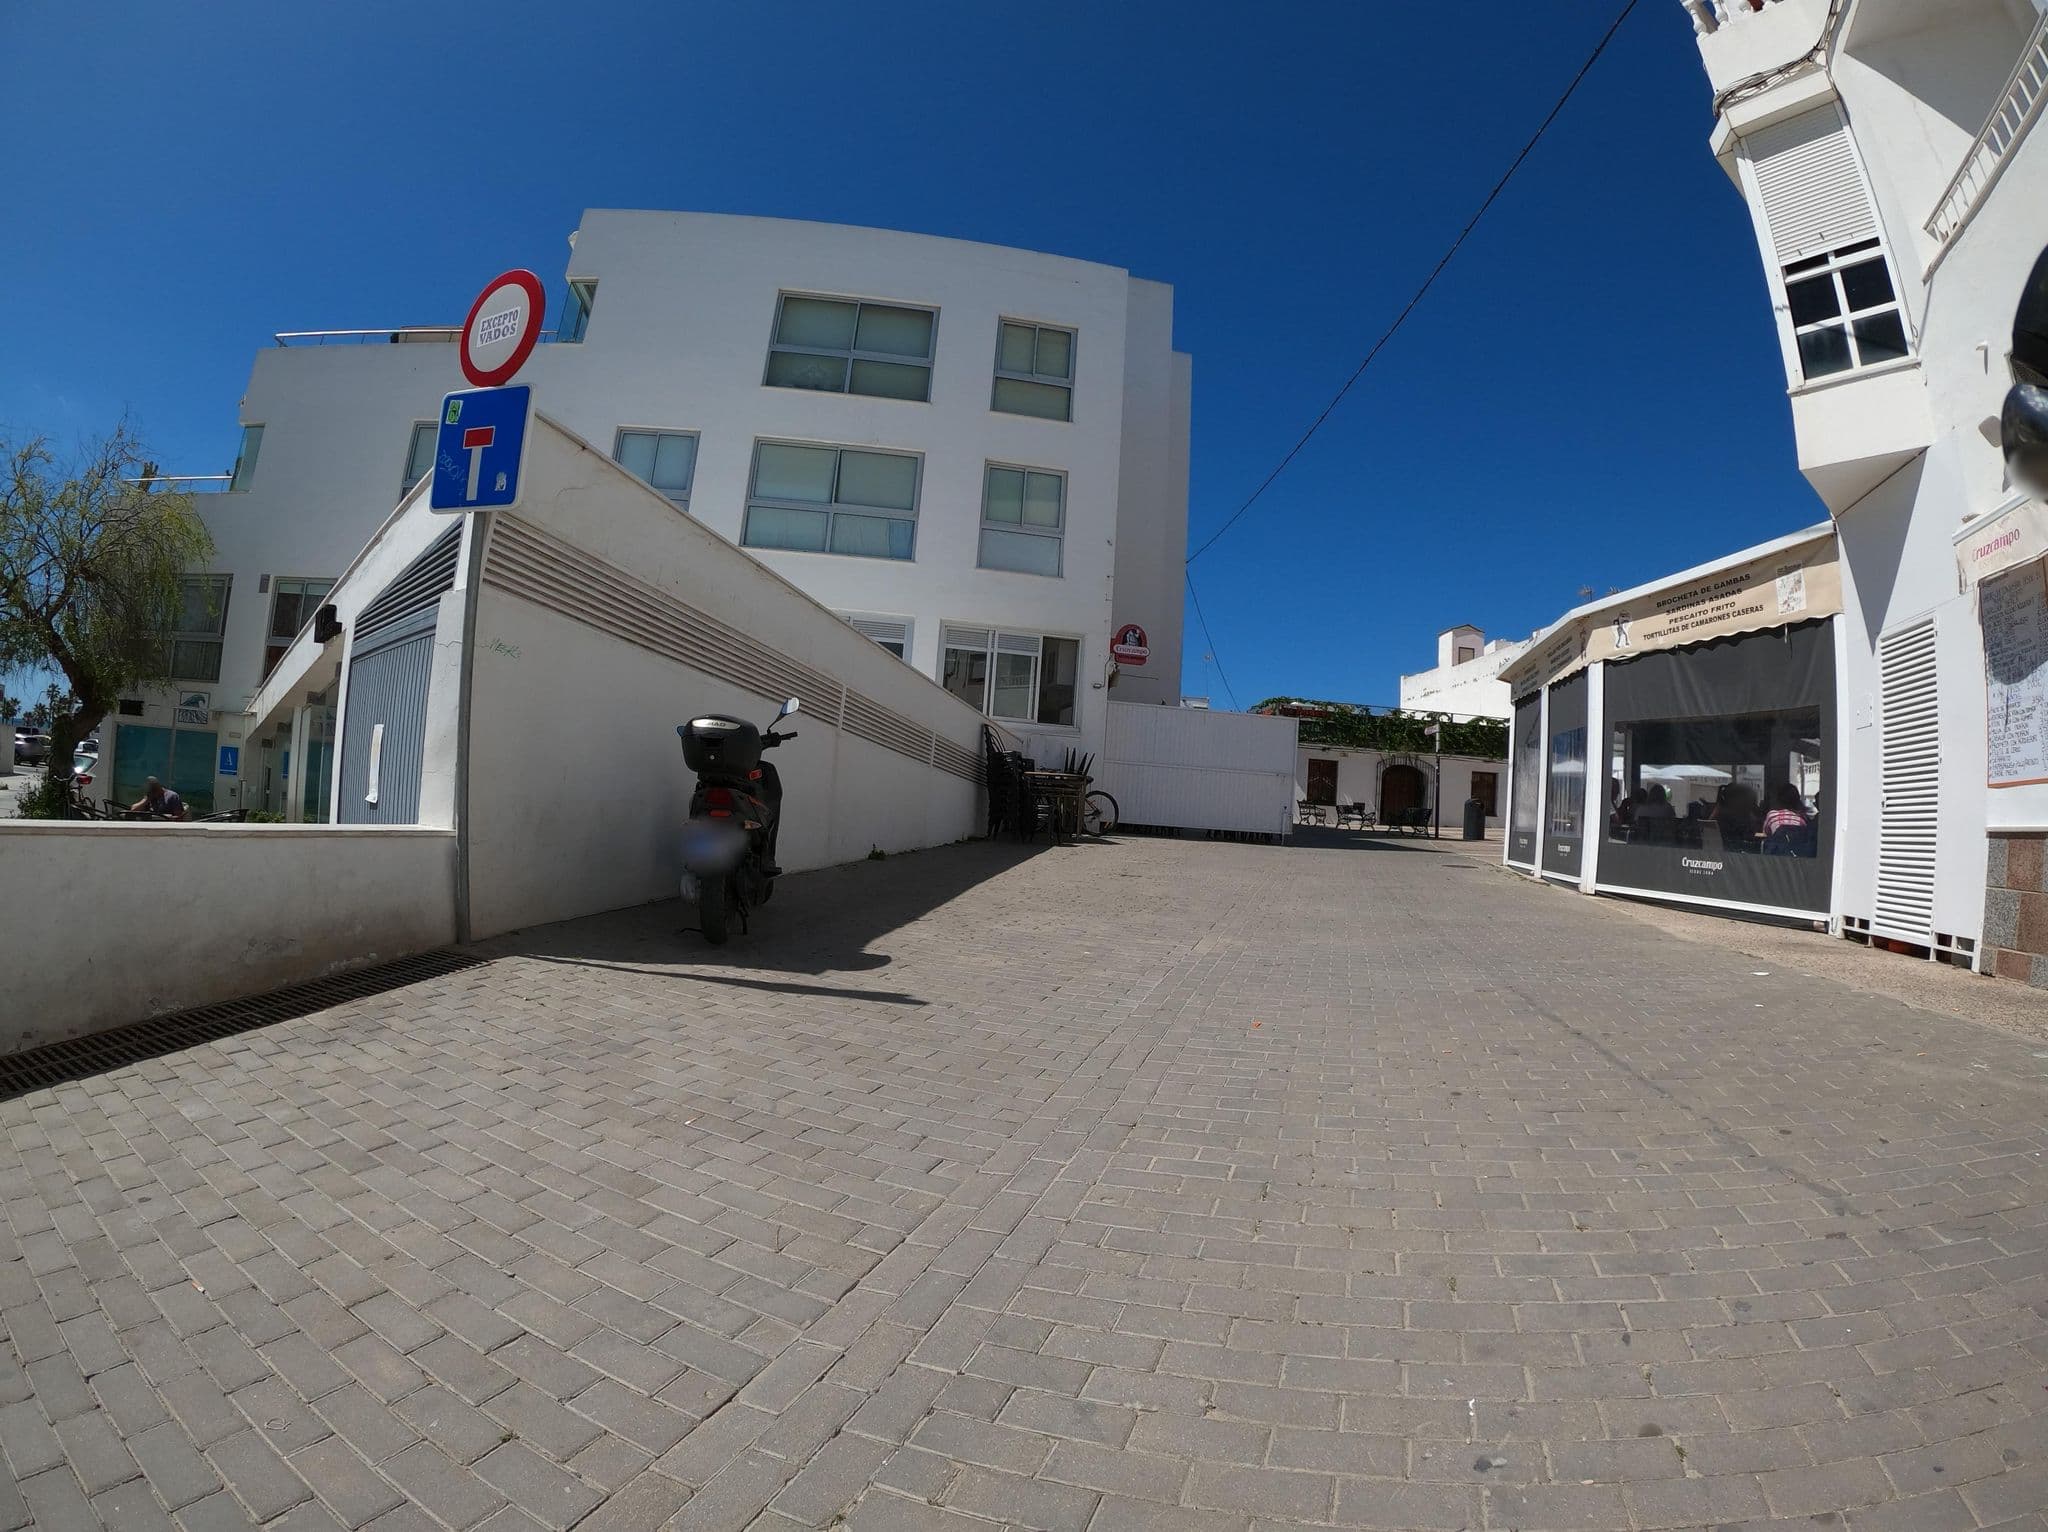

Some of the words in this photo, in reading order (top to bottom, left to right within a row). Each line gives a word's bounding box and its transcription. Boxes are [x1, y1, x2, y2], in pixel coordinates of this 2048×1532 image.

[480, 308, 519, 332] EXCEPTO
[479, 323, 517, 344] VADOS
[1656, 589, 1699, 608] BROCHETA
[1701, 584, 1713, 595] DE
[1713, 573, 1751, 590] GAMBAS
[1665, 598, 1706, 616] SARDINAS
[1708, 588, 1743, 604] ASADAS
[1643, 625, 1680, 641] TORTILLITAS
[1681, 623, 1689, 632] DE
[1691, 612, 1731, 629] CAMARONES
[1732, 604, 1764, 618] CASERAS
[1668, 609, 1709, 625] PESCAITO
[1710, 601, 1736, 614] FRITO
[1681, 856, 1723, 871] Cruzcampo
